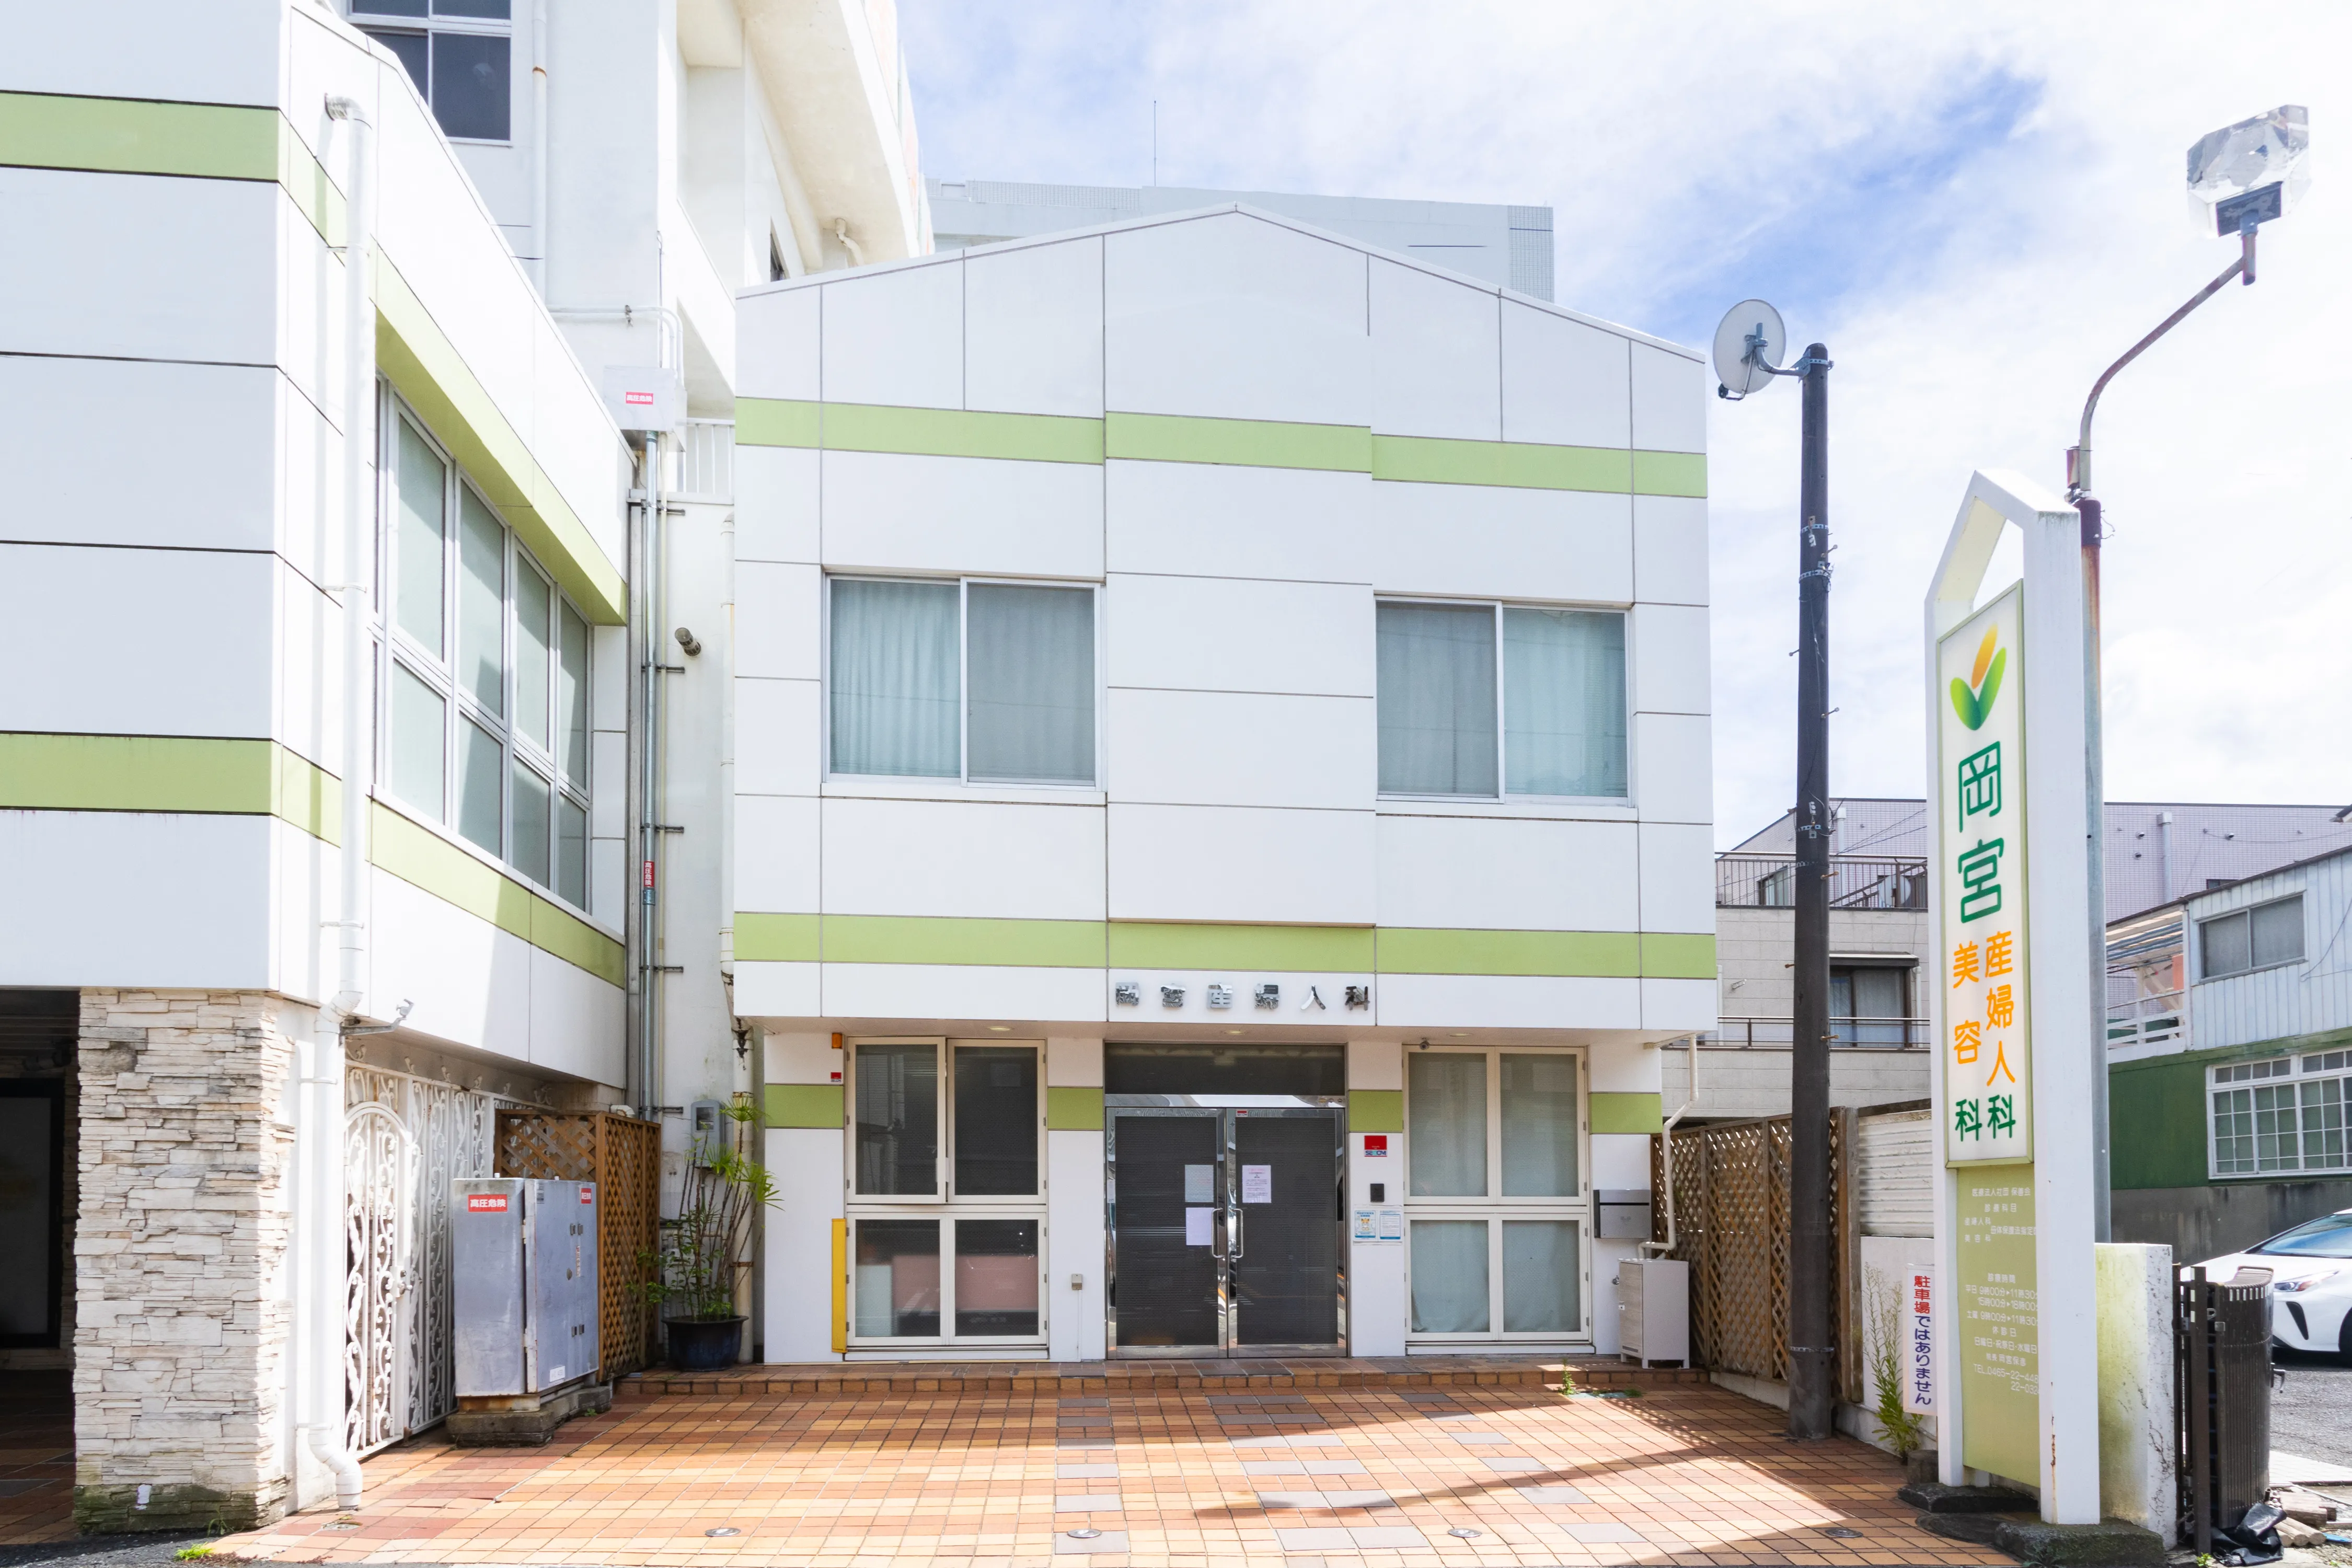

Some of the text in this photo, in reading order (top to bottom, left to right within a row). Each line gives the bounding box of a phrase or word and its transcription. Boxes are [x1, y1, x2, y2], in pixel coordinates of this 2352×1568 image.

[1958, 741, 2004, 924] 岡宮
[1952, 941, 1982, 1143] 美容科
[1985, 931, 2016, 1139] 産婦人科
[470, 1199, 506, 1207] 高圧危険
[1913, 1275, 1932, 1405] 駐車場ではありません
[1965, 1284, 1977, 1294] 平日
[2011, 1381, 2039, 1395] 22-032
